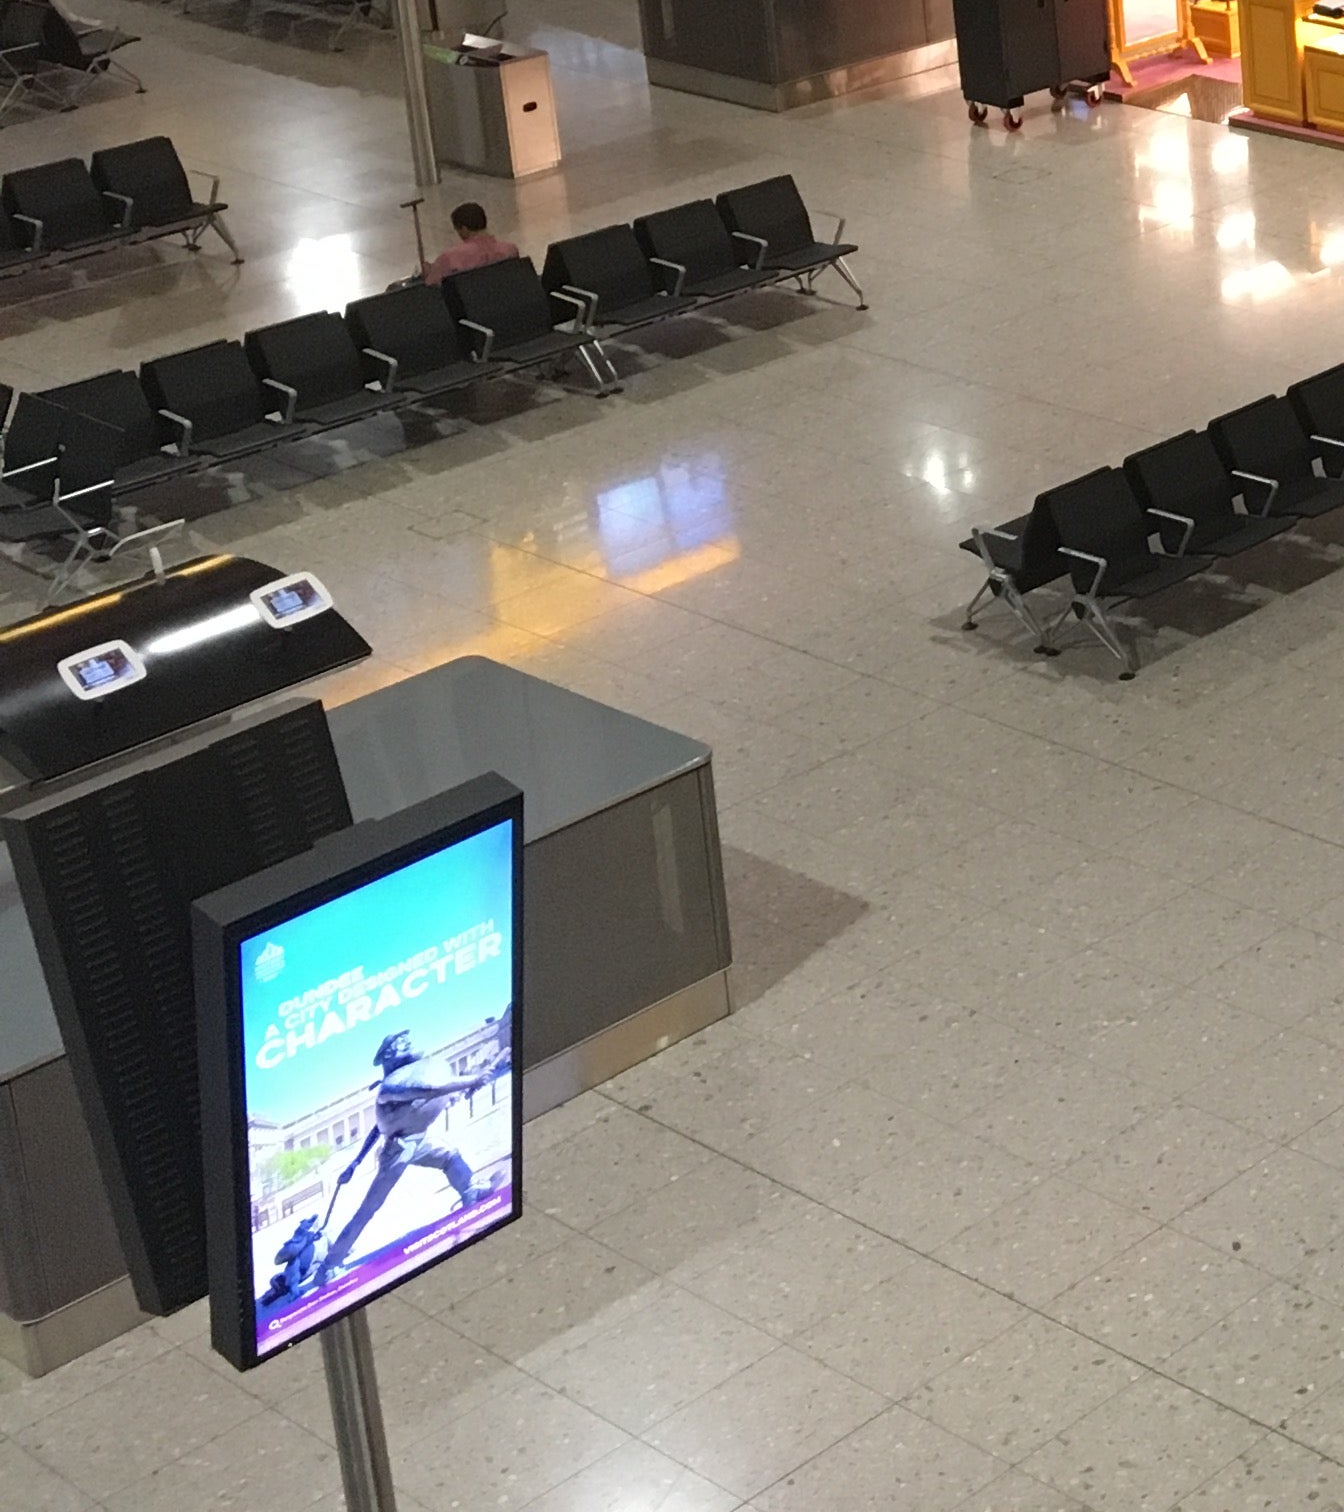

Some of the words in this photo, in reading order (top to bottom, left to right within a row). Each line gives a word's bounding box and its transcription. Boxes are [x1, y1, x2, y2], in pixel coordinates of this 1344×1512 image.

[255, 932, 502, 1070] CHARACTER
[264, 1023, 281, 1040] A
[284, 995, 333, 1030] CITY
[337, 946, 438, 1005] DESIGNED
[443, 918, 495, 953] WITH
[278, 965, 365, 1018] DUNDEE
